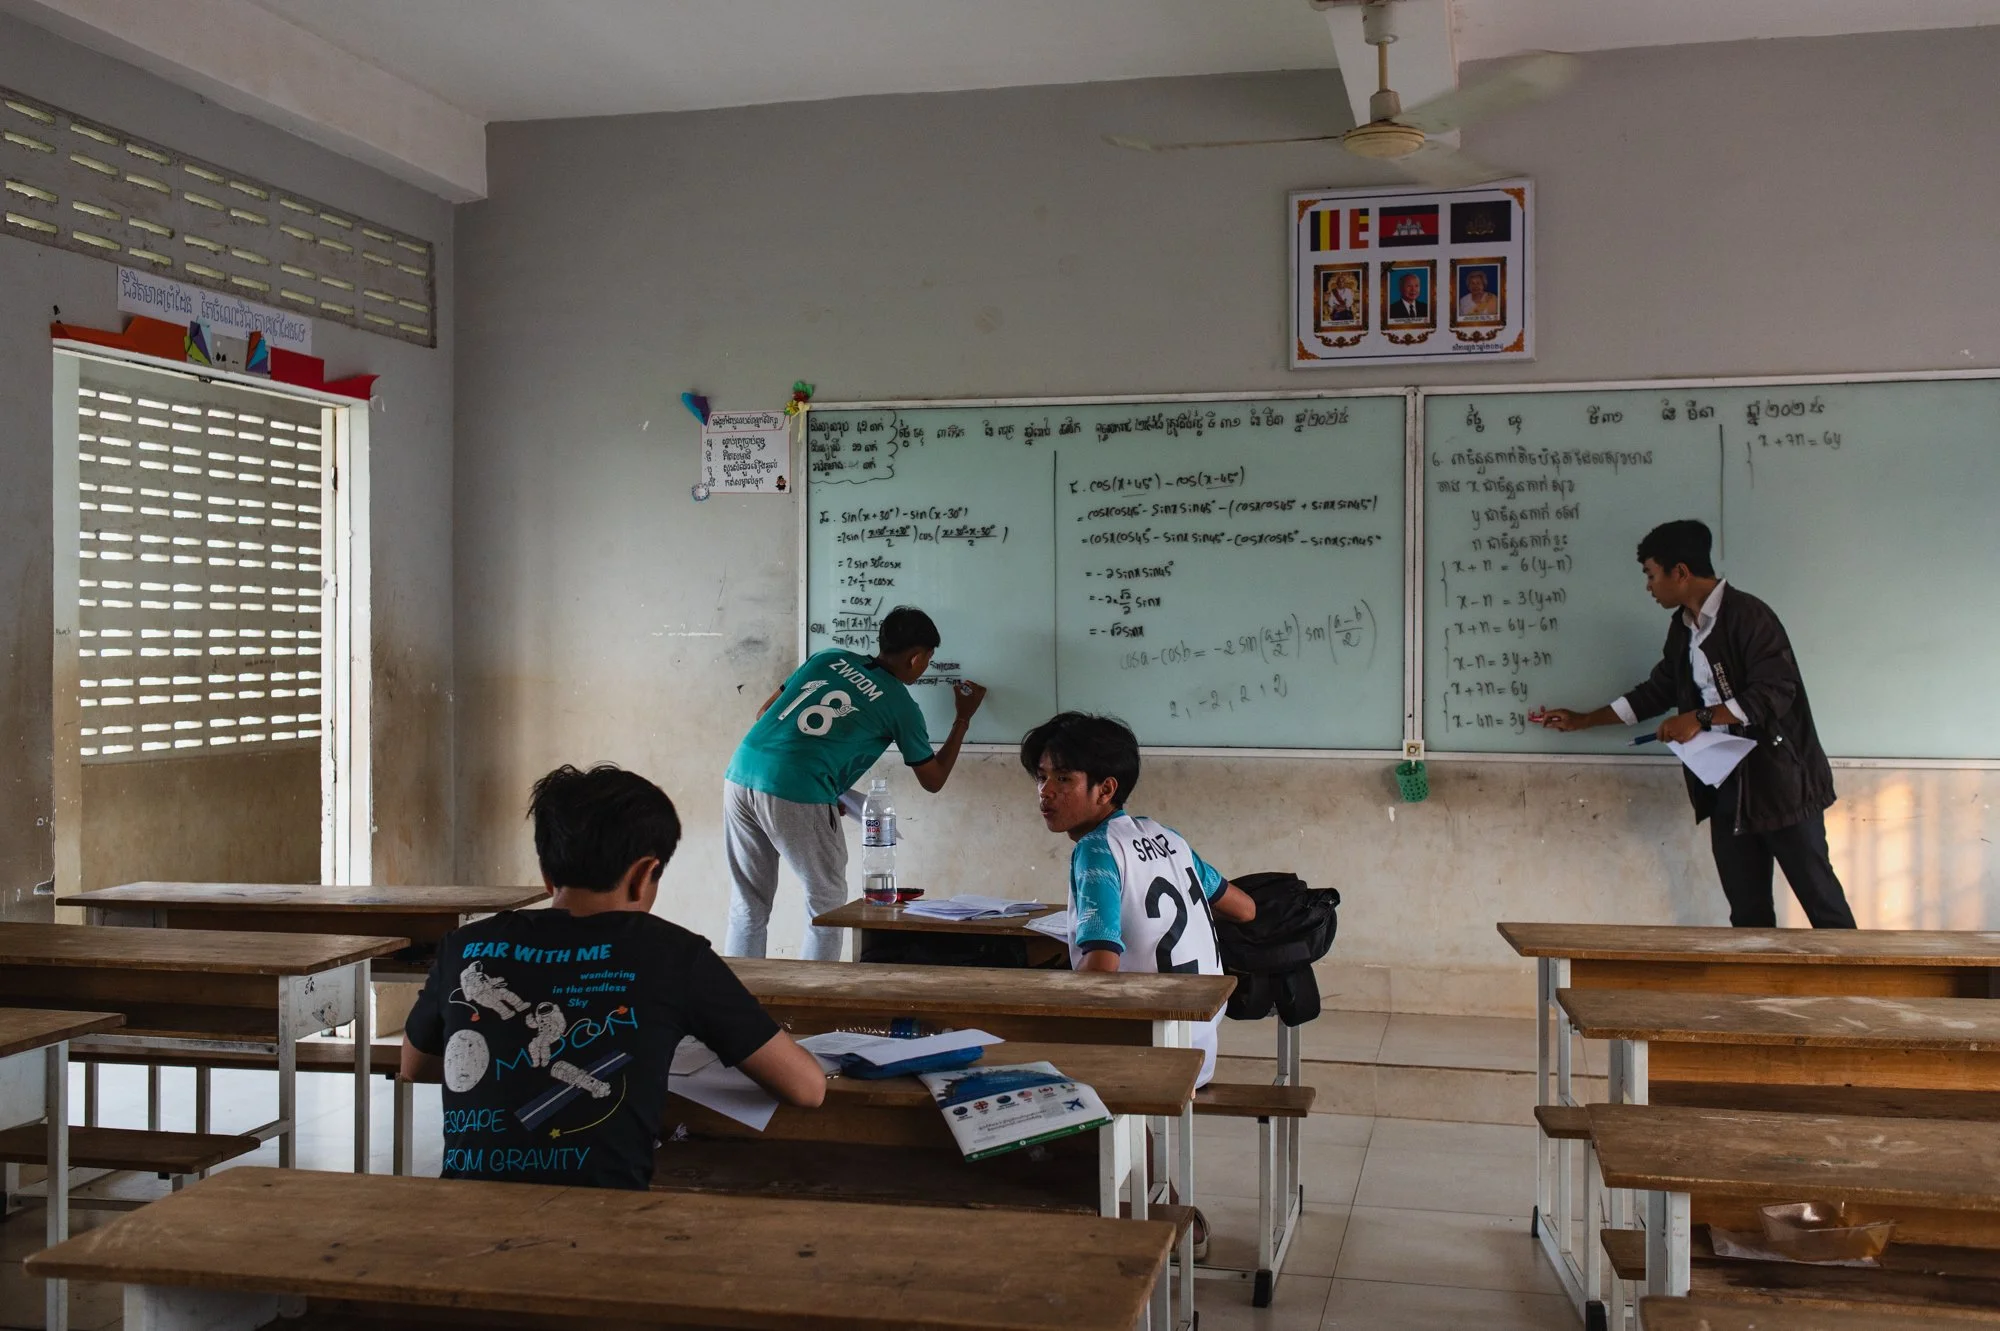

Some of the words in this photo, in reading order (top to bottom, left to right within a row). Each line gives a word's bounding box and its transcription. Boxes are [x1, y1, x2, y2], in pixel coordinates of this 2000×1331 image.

[778, 680, 860, 736] 18
[462, 942, 512, 960] BEAR
[514, 944, 570, 964] WITH
[576, 944, 612, 962] ME
[580, 970, 636, 982] wandering
[552, 984, 564, 994] in
[566, 984, 584, 994] the
[584, 982, 628, 994] endless
[566, 998, 590, 1008] Sky
[444, 1108, 508, 1134] ESCAPE
[488, 1146, 590, 1172] GRAVITY
